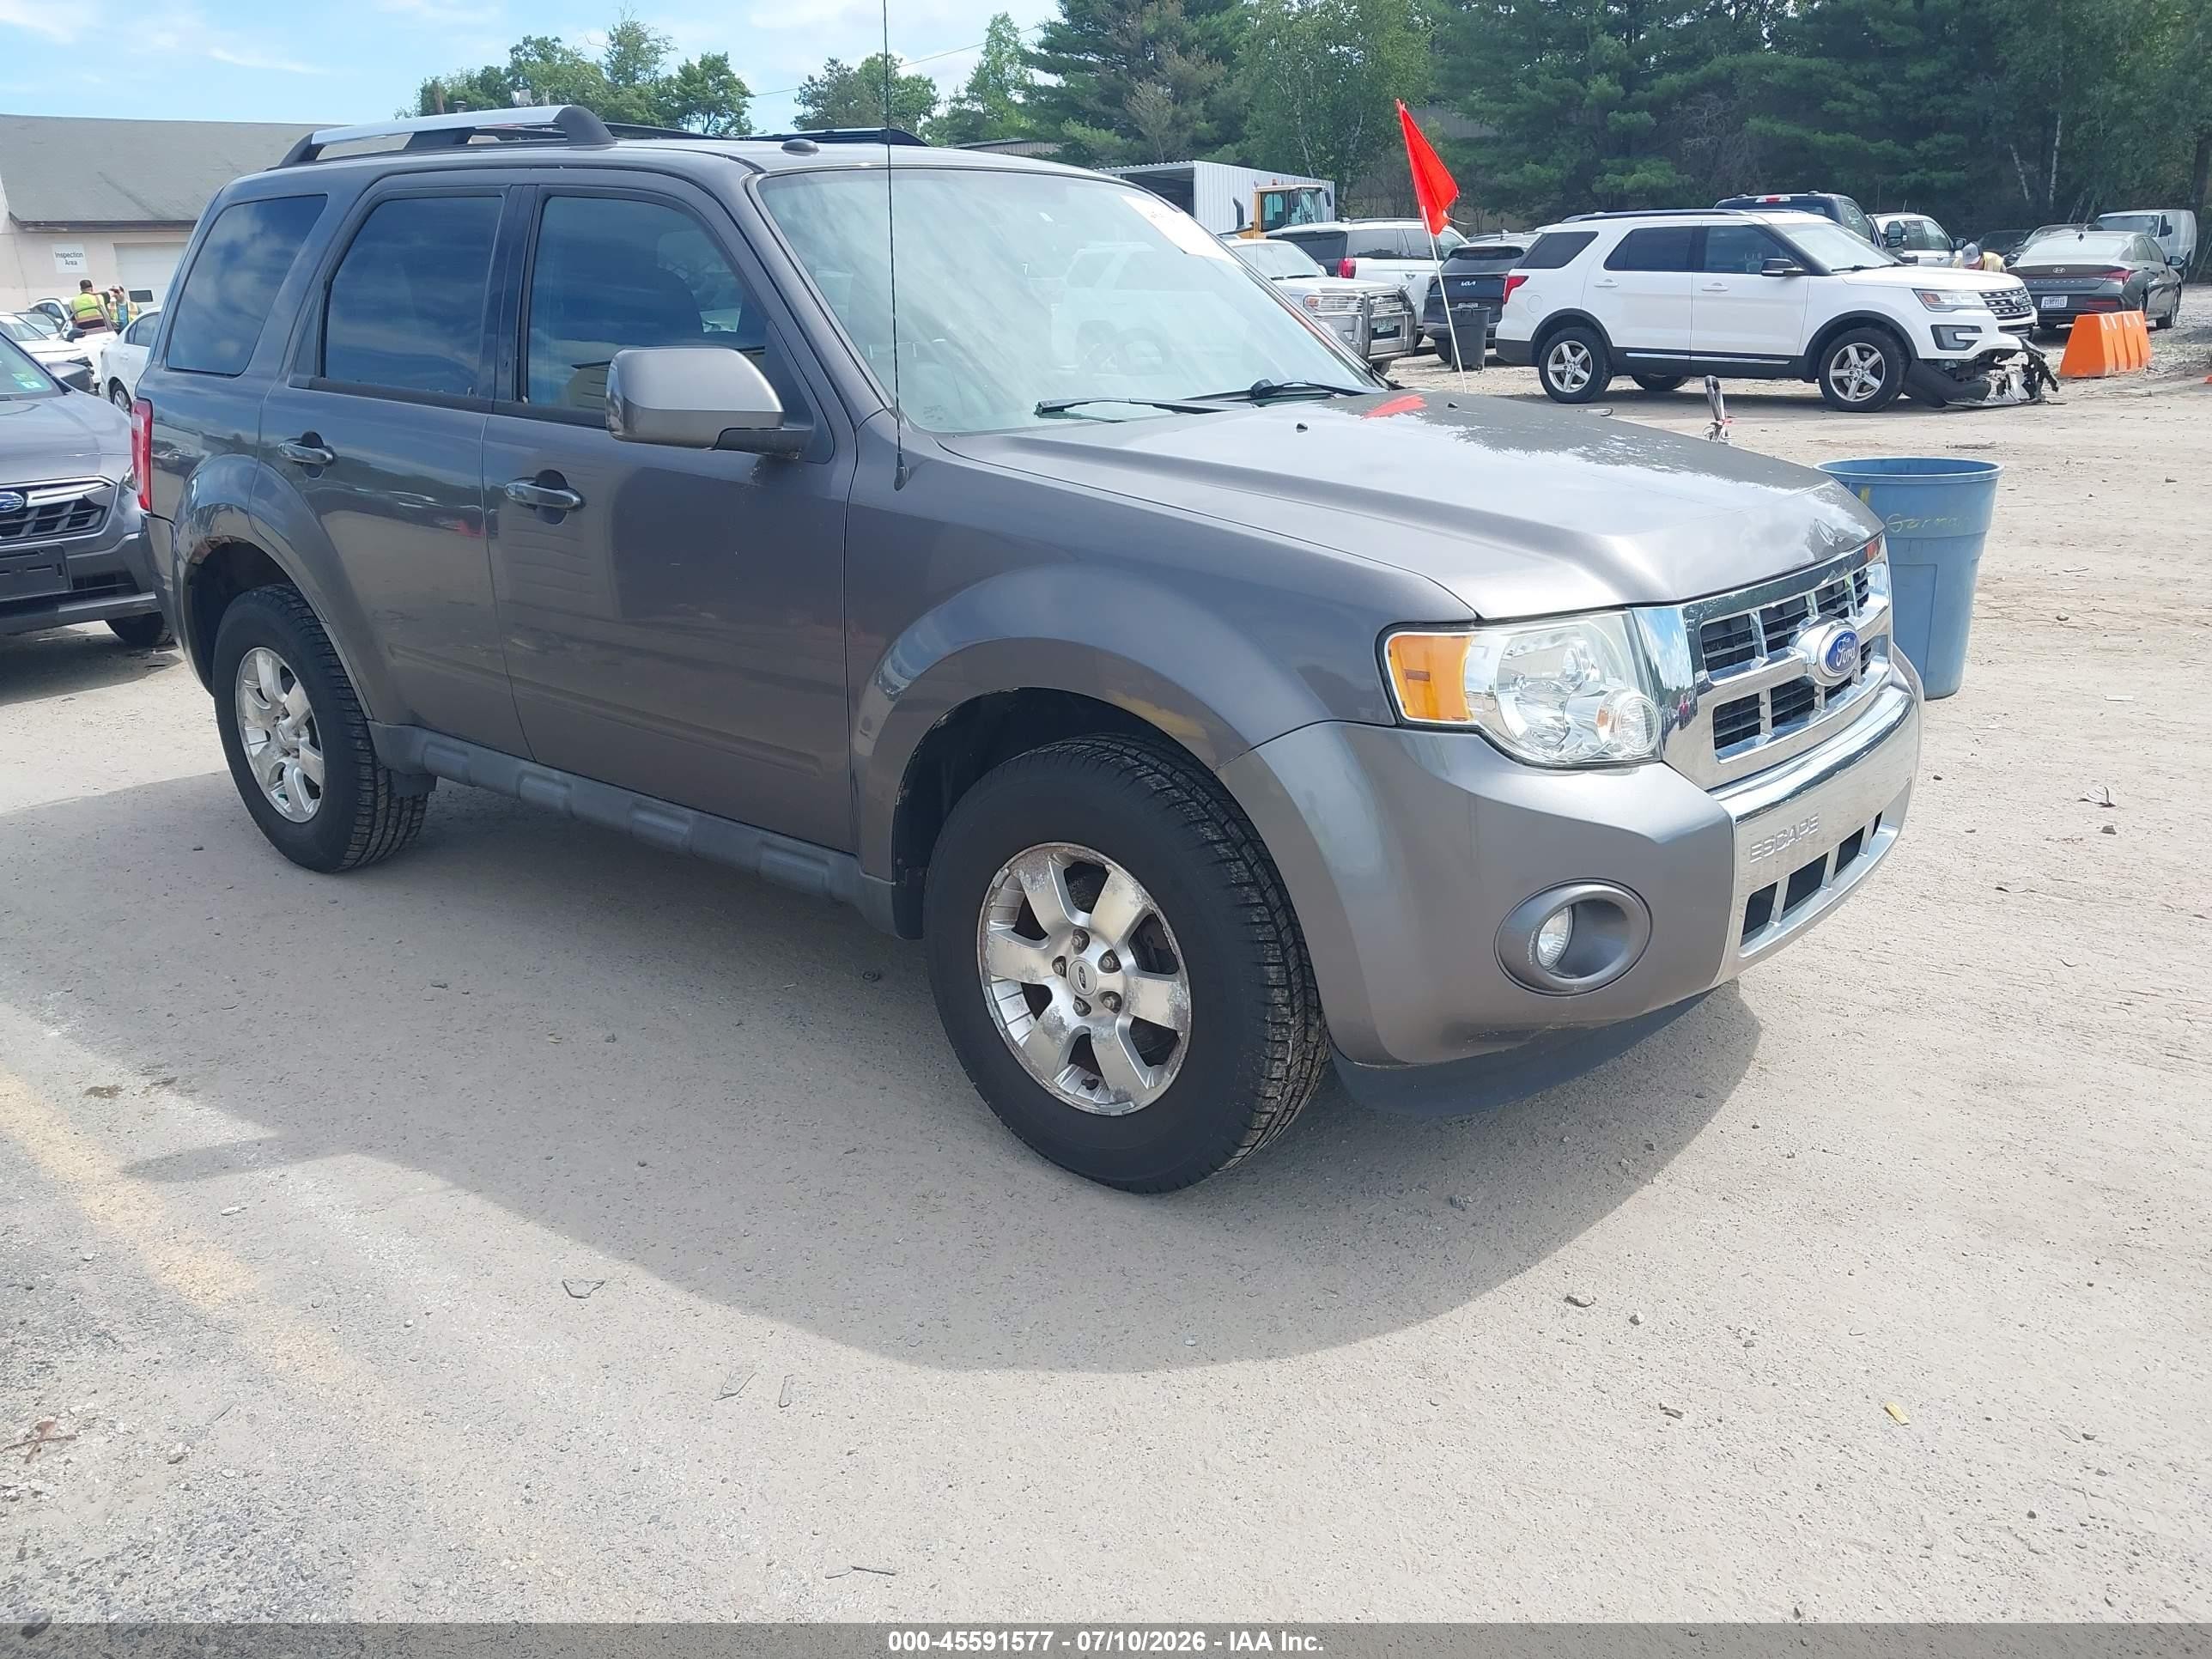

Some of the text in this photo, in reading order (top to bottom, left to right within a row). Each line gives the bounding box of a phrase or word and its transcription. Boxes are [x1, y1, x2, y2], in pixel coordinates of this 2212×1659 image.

[54, 251, 84, 259] Inspection
[1836, 636, 1856, 667] Ford
[1749, 814, 1820, 863] ESCAPE
